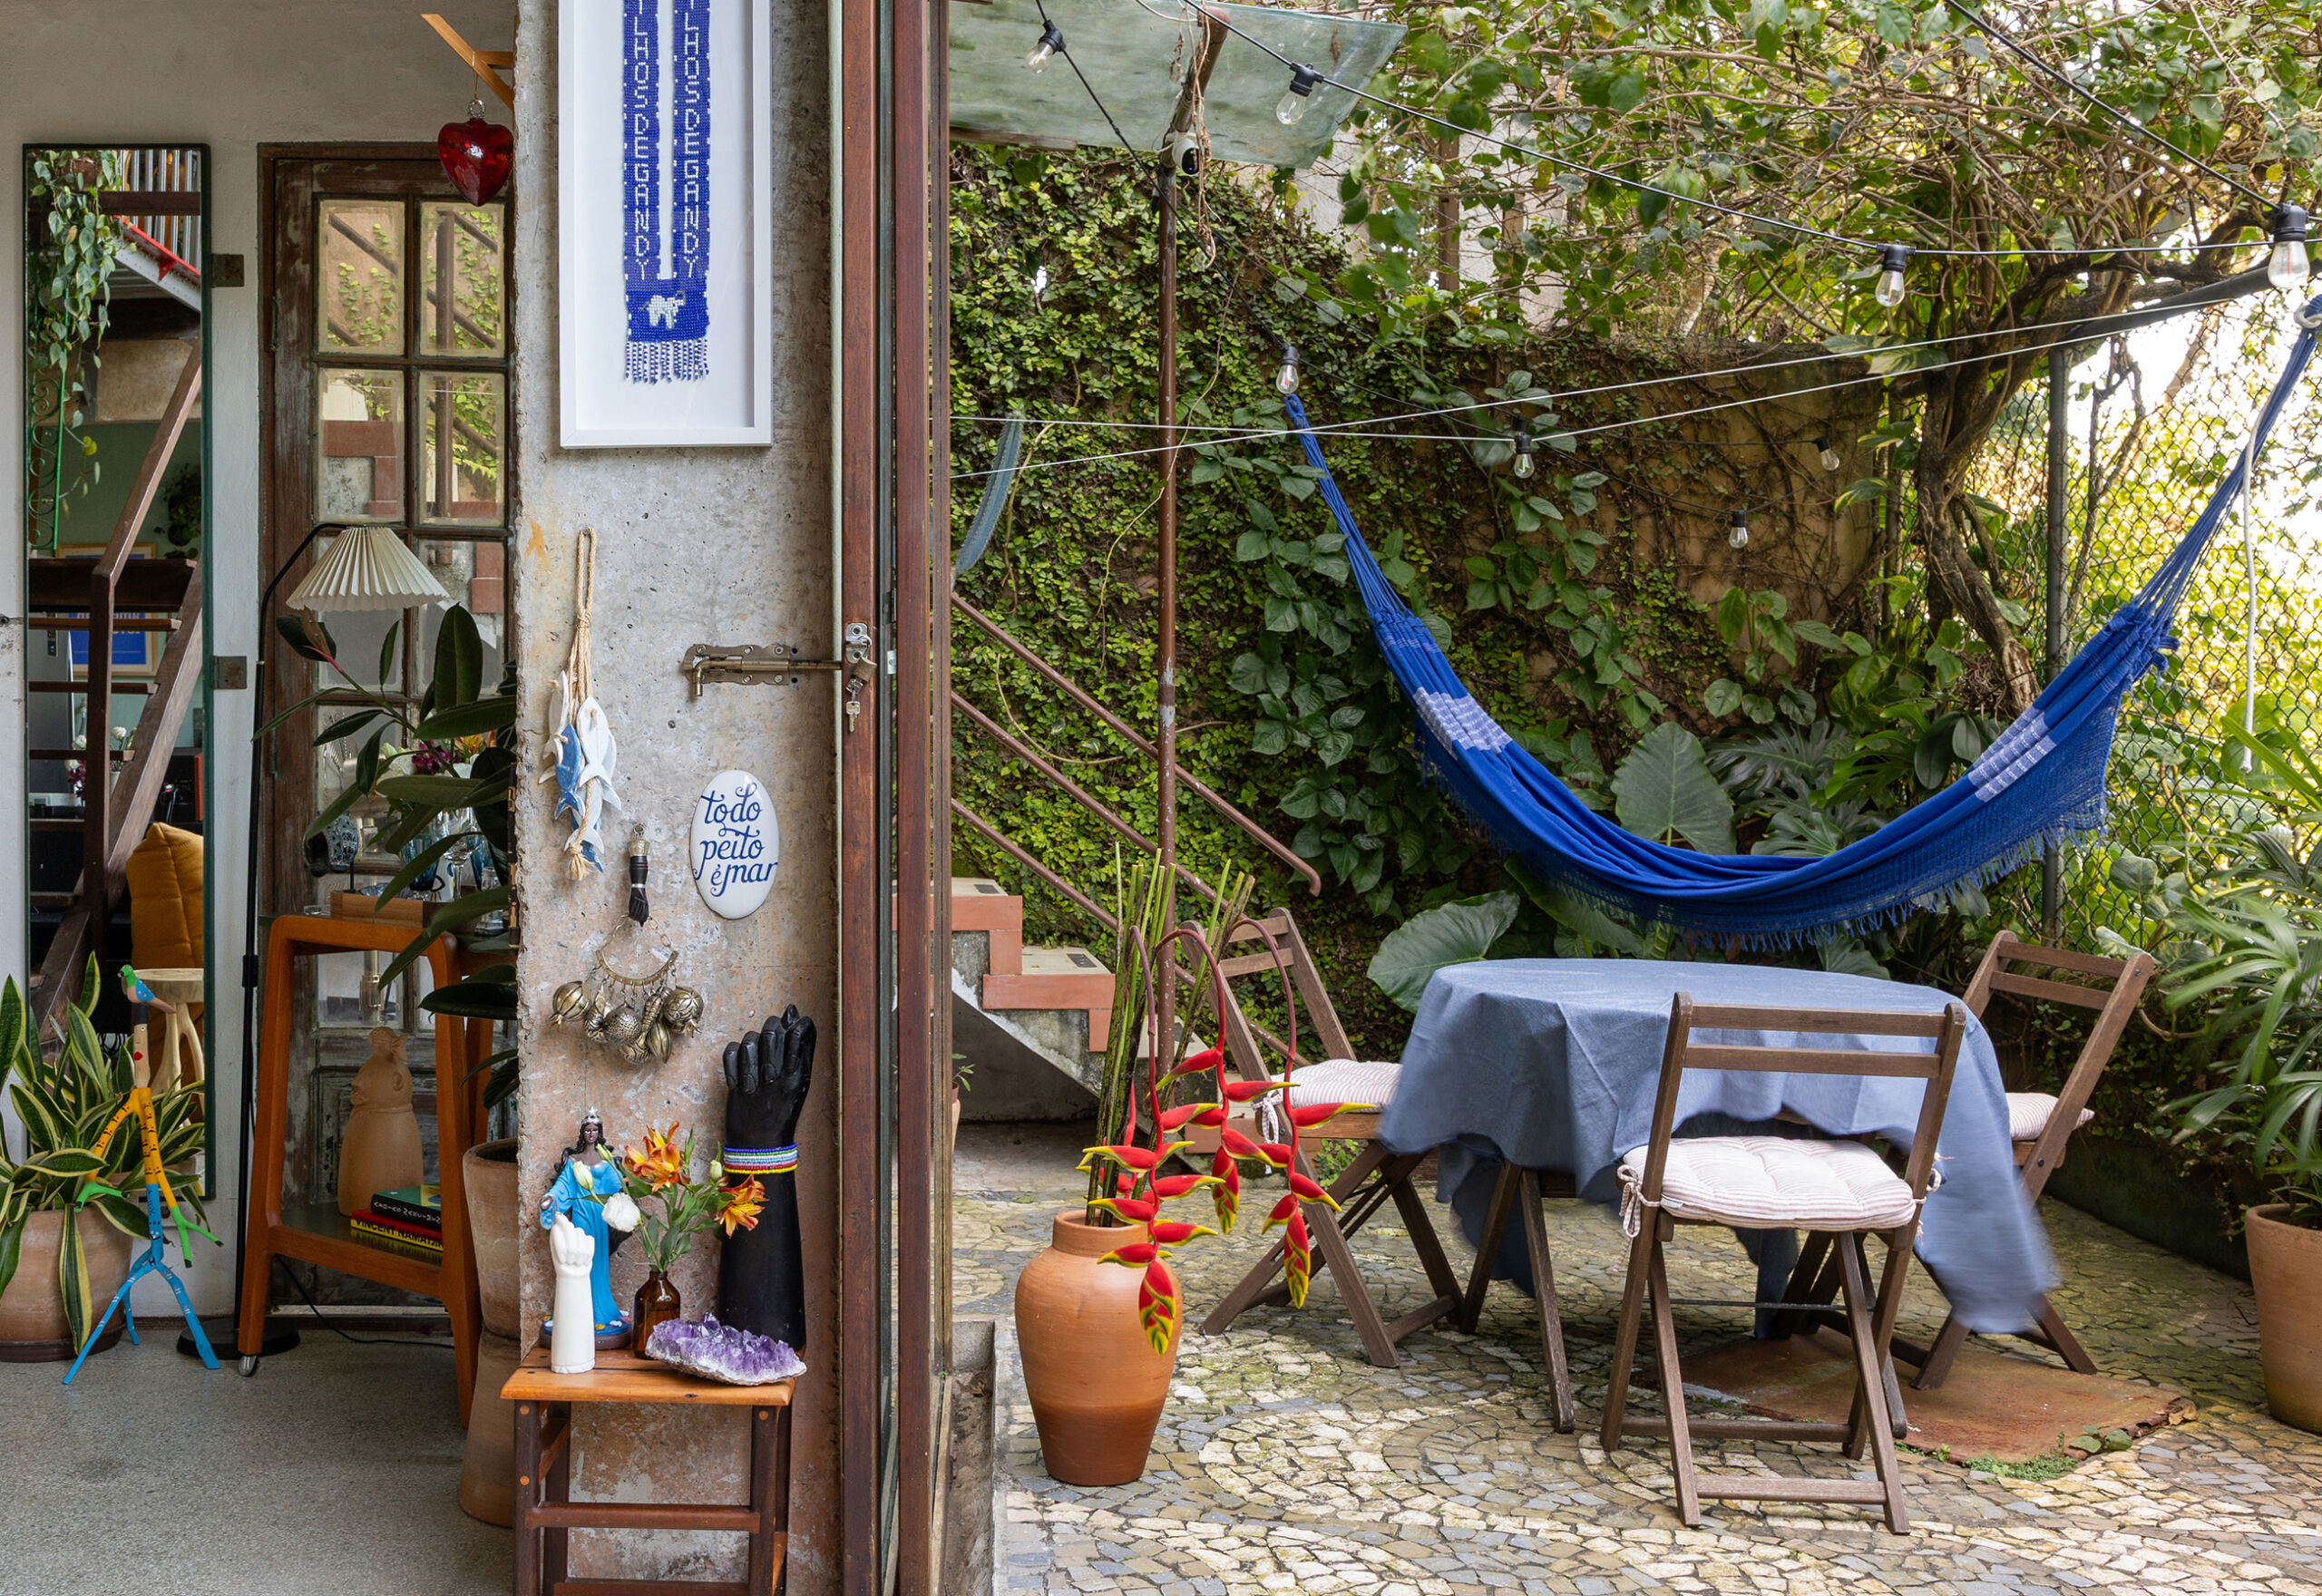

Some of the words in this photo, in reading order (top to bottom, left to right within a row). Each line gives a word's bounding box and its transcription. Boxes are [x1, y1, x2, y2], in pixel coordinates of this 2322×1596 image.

[701, 783, 763, 823] todo
[692, 825, 765, 881] peito
[710, 861, 778, 897] mar
[355, 1215, 396, 1236] VINCENT
